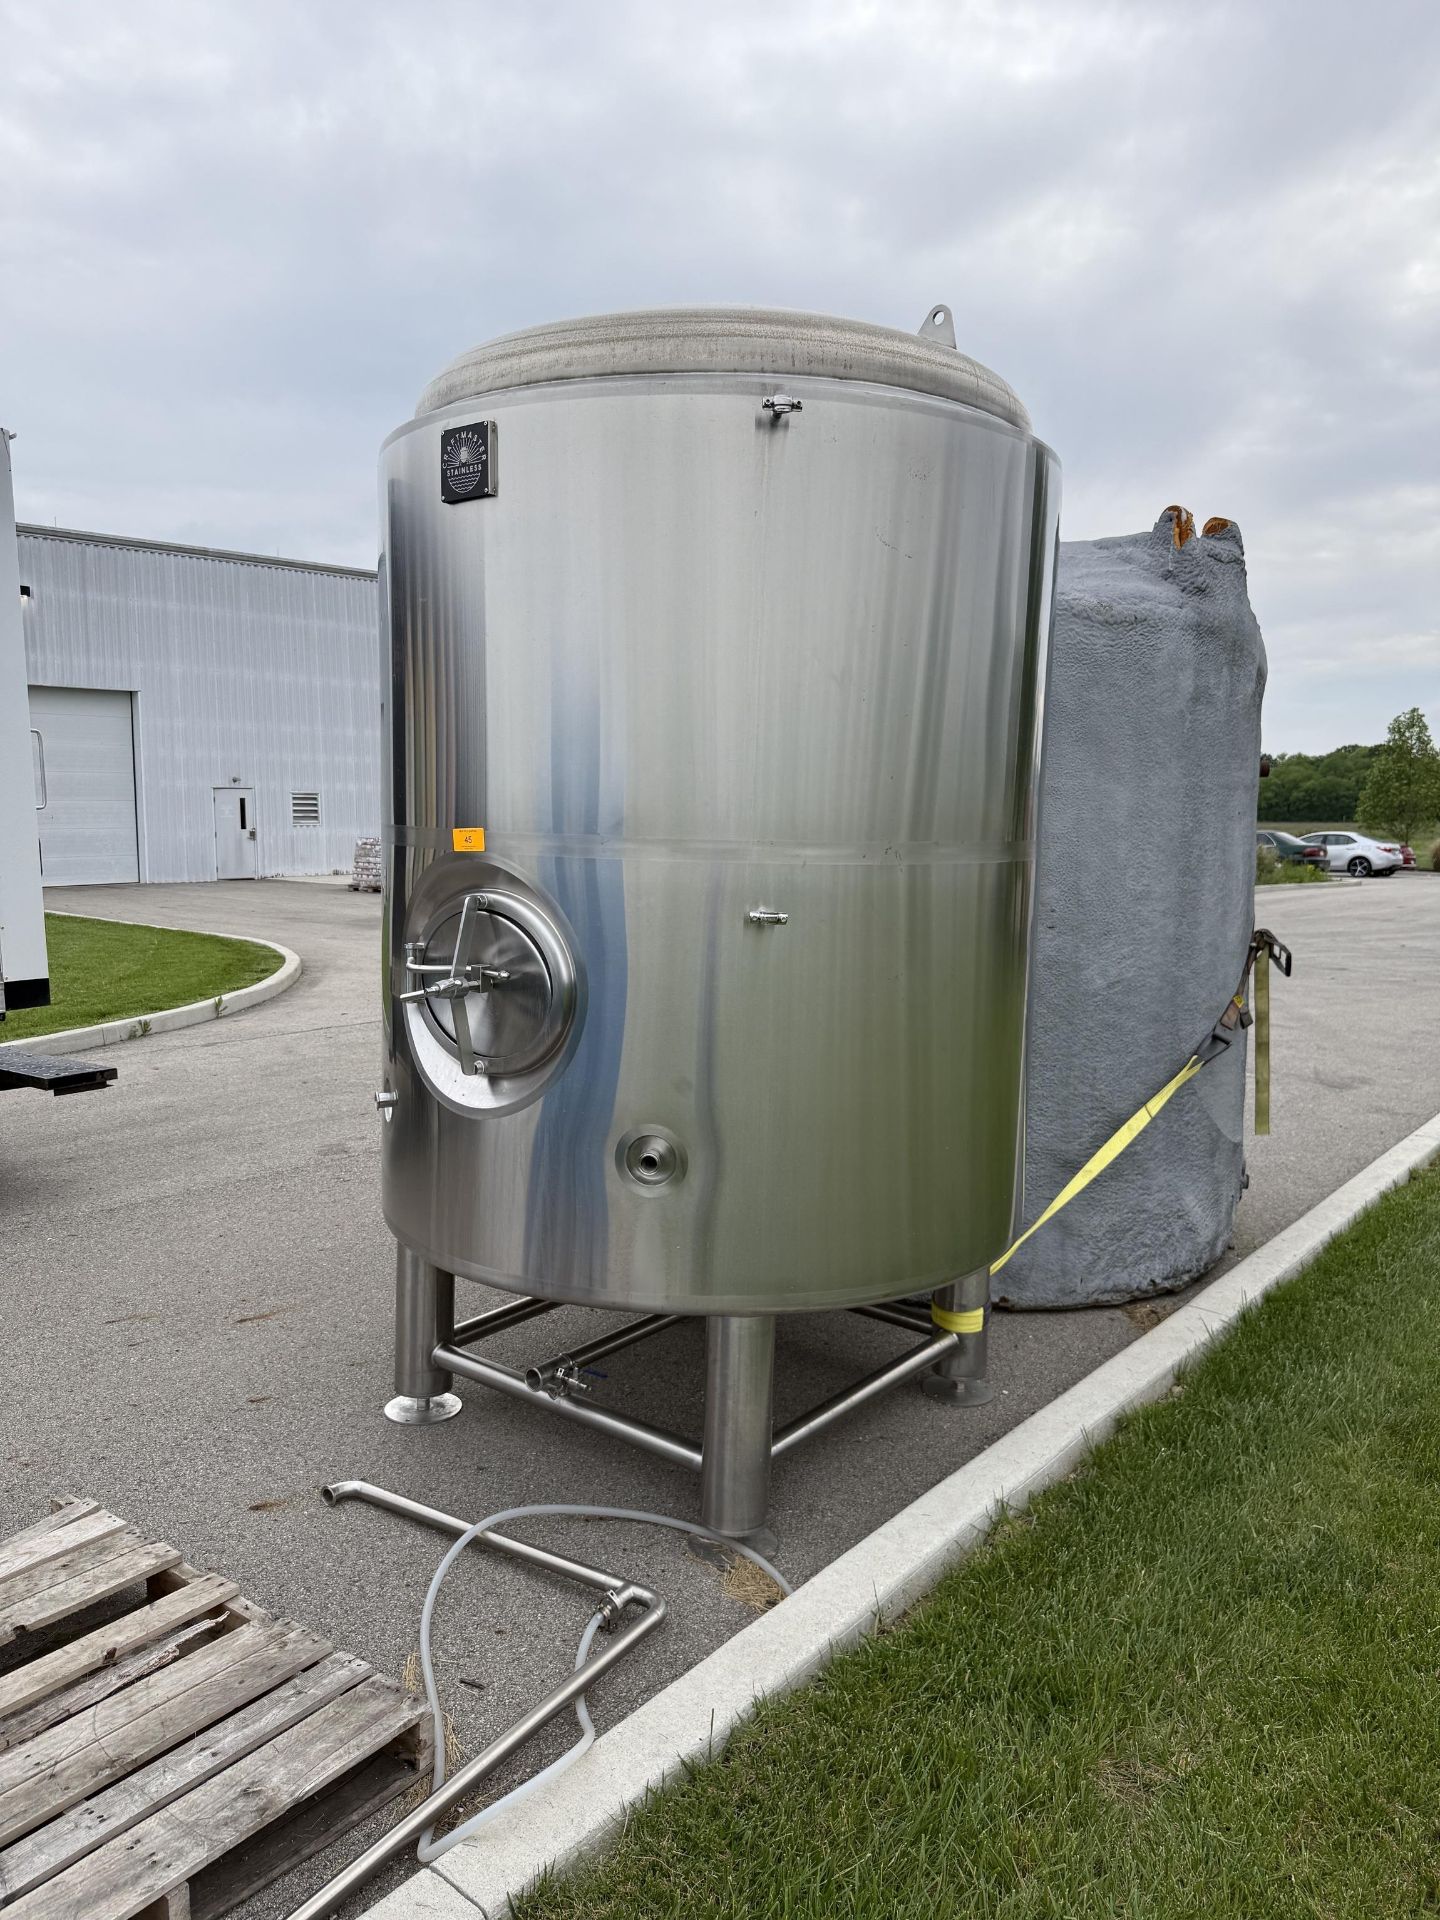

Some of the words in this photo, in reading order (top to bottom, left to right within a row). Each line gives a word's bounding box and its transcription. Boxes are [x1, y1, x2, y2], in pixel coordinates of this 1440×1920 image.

[442, 430, 487, 469] CRAFTMASTER
[446, 463, 482, 477] STAINLESS
[464, 835, 472, 843] 45
